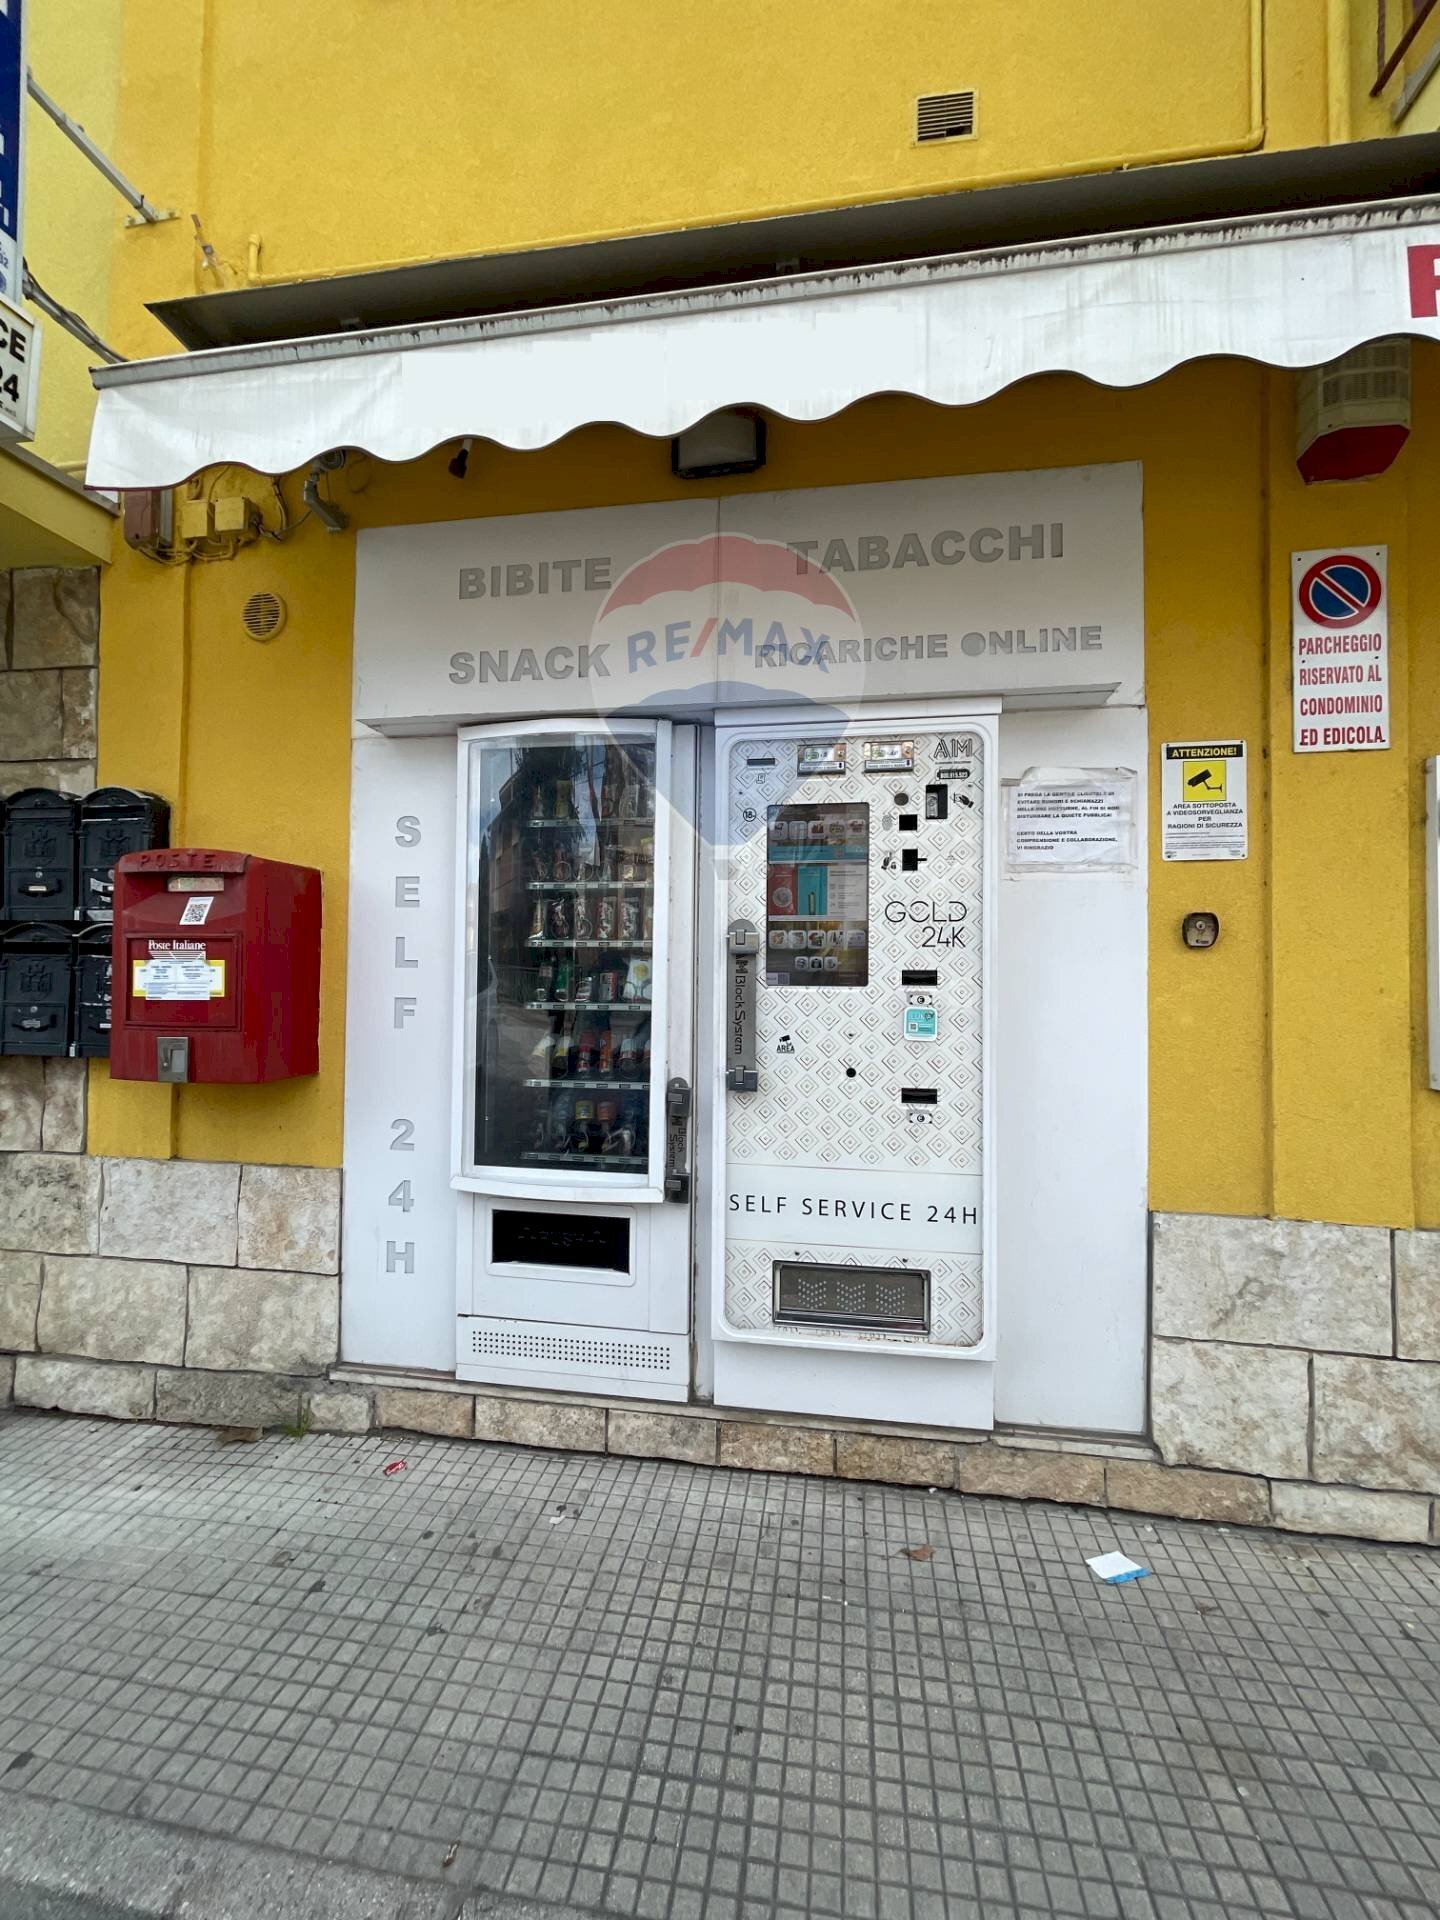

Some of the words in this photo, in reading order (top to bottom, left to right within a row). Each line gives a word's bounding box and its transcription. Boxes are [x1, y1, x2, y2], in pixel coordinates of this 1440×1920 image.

[788, 523, 1064, 575] TABACCHI
[459, 557, 611, 599] BIBITE
[755, 633, 948, 668] RICARICHE
[960, 626, 1103, 657] ONLINE
[1299, 633, 1382, 655] PARCHEGGIO
[449, 643, 611, 683] SNACK
[1300, 665, 1363, 686] RISERVATO
[1367, 664, 1382, 682] AL
[1300, 695, 1383, 716] CONDOMINIO
[1300, 728, 1318, 746] ED
[1323, 726, 1383, 745] EDICOLA
[1172, 747, 1237, 758] ATTENZIONE!
[140, 854, 216, 868] POSTE
[394, 815, 421, 1029] SELF
[884, 900, 967, 923] GOLD
[148, 939, 171, 950] Poste
[173, 939, 206, 950] Italiane
[921, 926, 966, 948] 24K
[386, 1118, 415, 1274] 24H
[729, 1193, 787, 1214] SELF
[801, 1198, 912, 1221] SERVICE
[927, 1205, 977, 1225] 24H
